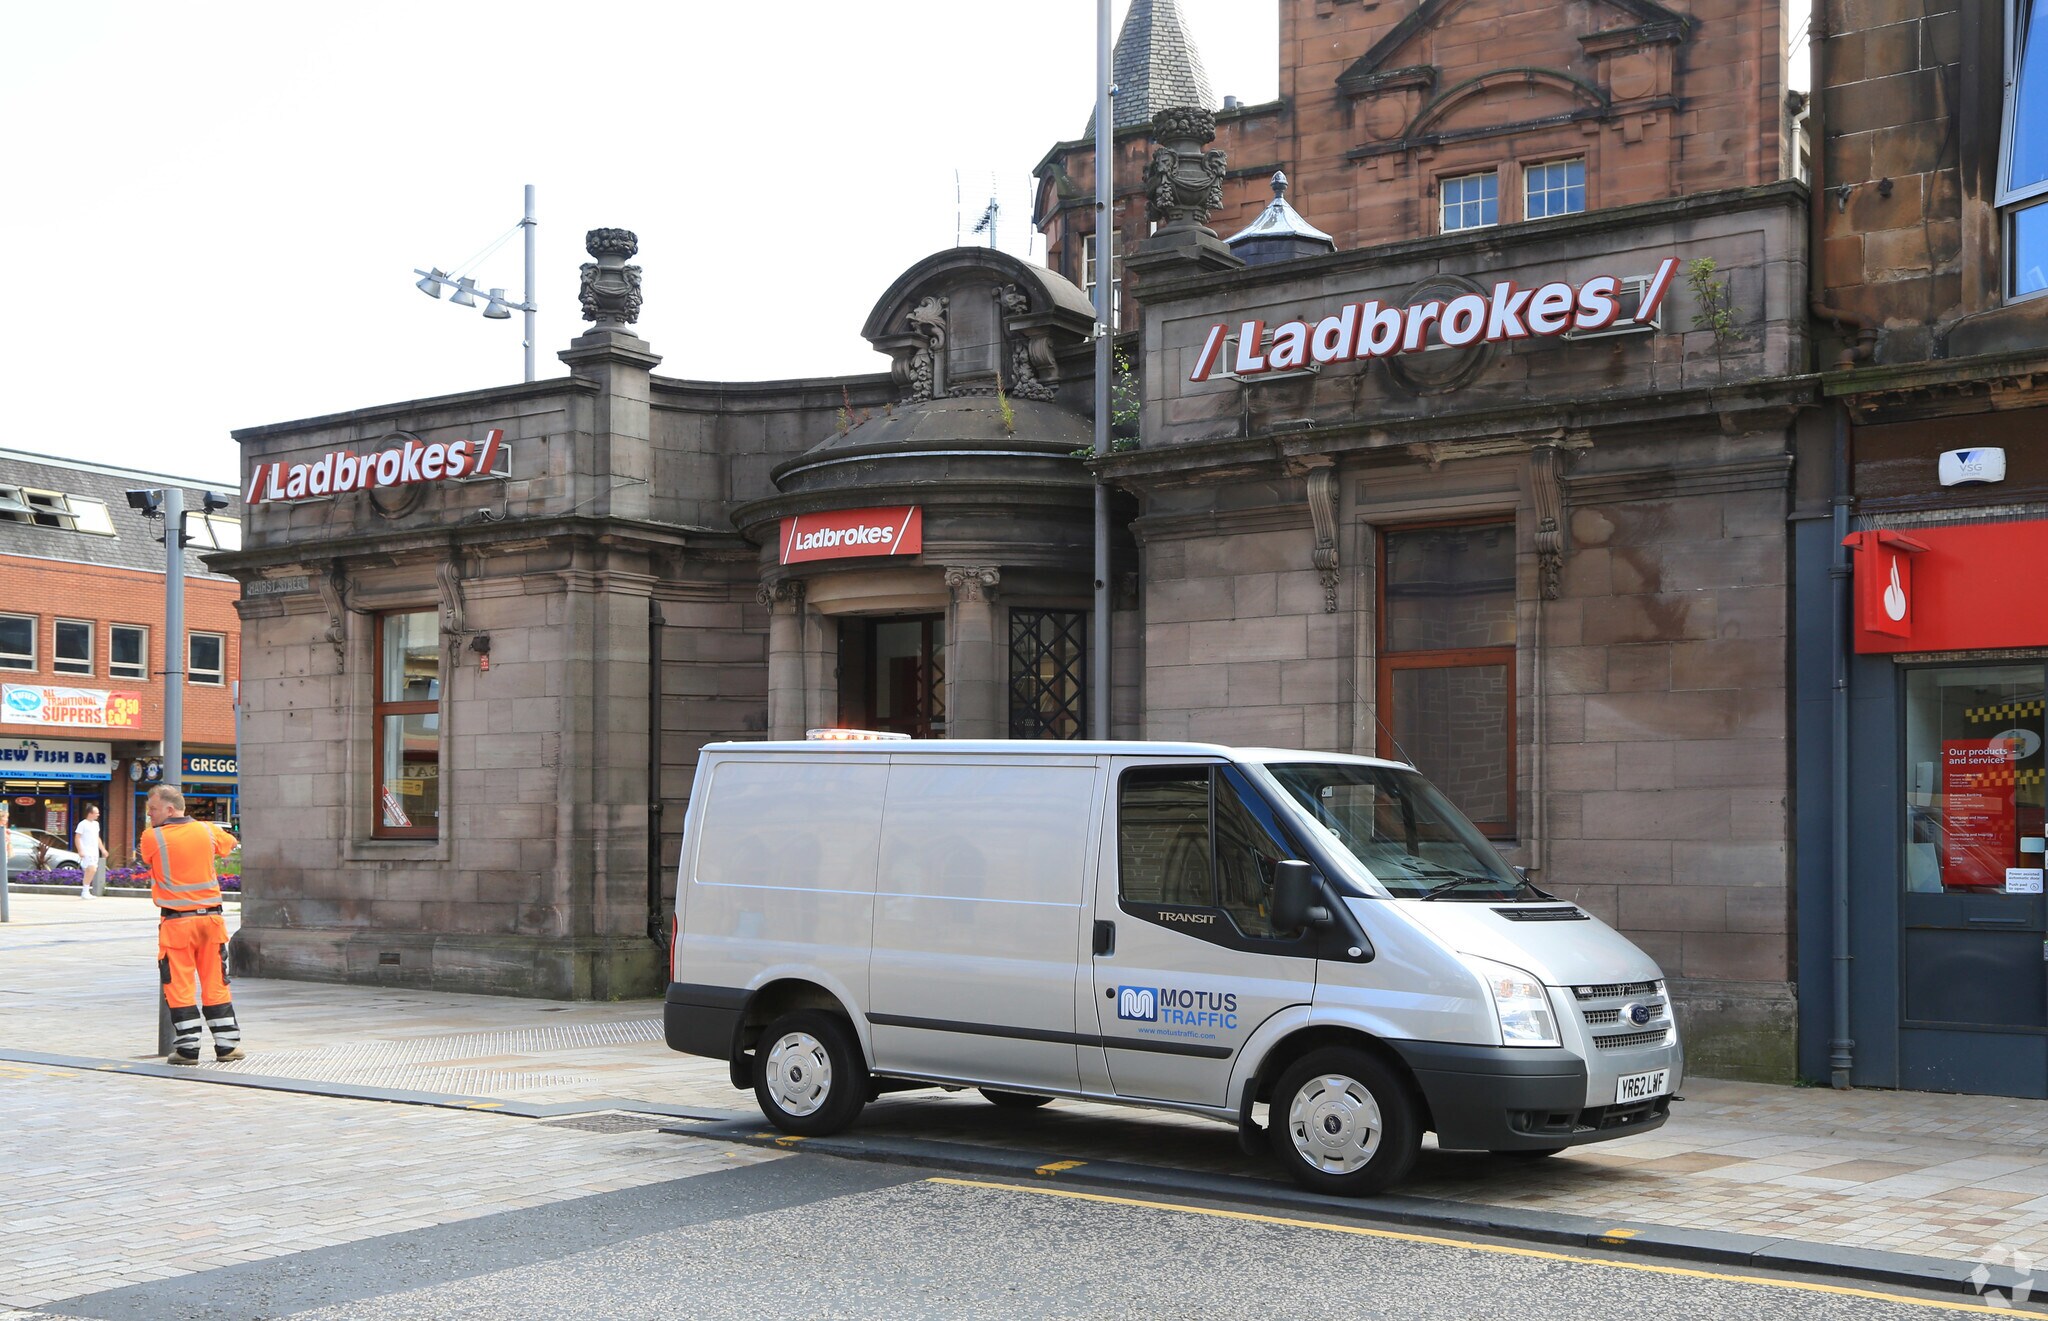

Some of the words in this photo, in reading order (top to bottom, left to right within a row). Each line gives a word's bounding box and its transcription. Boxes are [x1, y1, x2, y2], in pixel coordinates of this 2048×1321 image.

[1236, 276, 1620, 373] Ladbrokes
[270, 440, 473, 500] Ladbrokes
[1960, 464, 1983, 472] VSG
[796, 525, 893, 551] Ladbrokes
[43, 689, 55, 698] ALL
[48, 696, 97, 706] TRADITIONAL
[42, 706, 102, 724] SUPPERS
[34, 750, 69, 763] FISH
[74, 752, 106, 764] BAR
[1949, 748, 1967, 756] Our
[1968, 747, 2008, 757] products
[1949, 756, 1967, 765] and
[1968, 756, 2005, 764] services
[1158, 912, 1217, 924] TRANSIT
[1160, 988, 1238, 1012] MOTUS
[1161, 1009, 1238, 1030] TRAFFIC
[1138, 1027, 1216, 1040] www.motustraffic.com
[1622, 1076, 1646, 1099] YR62
